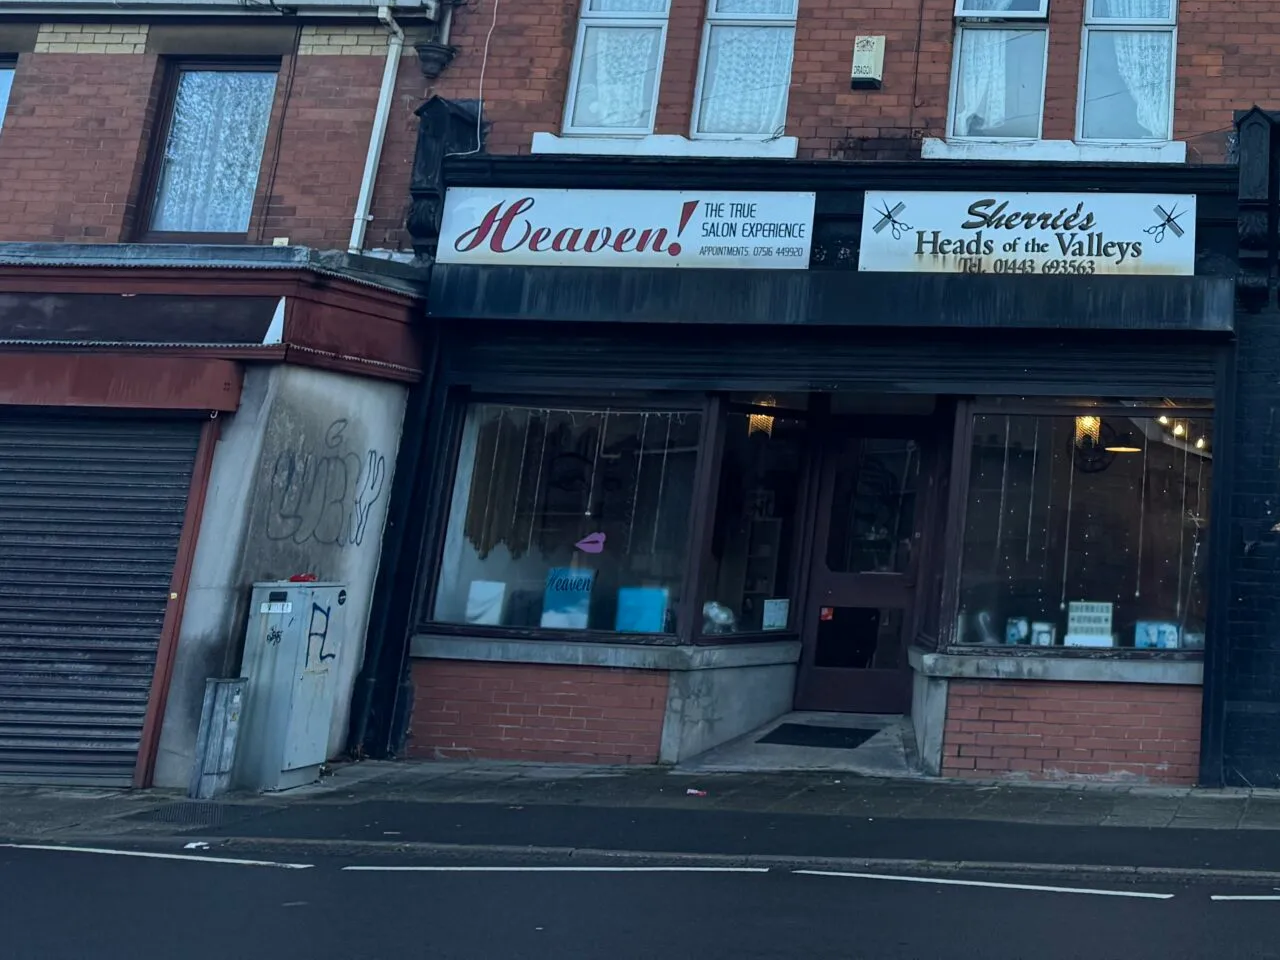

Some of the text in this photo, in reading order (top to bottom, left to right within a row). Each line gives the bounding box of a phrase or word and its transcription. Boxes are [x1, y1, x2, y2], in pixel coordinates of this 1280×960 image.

[704, 202, 757, 218] THE TRUE
[961, 199, 1097, 231] Sherrie's
[454, 197, 700, 257] Heaven!
[701, 222, 806, 239] SALON EXPERIENCE
[775, 246, 804, 257] 449920
[915, 230, 1143, 265] Heads of the Valleys
[993, 258, 1036, 273] 01443
[1041, 258, 1096, 275] 693563
